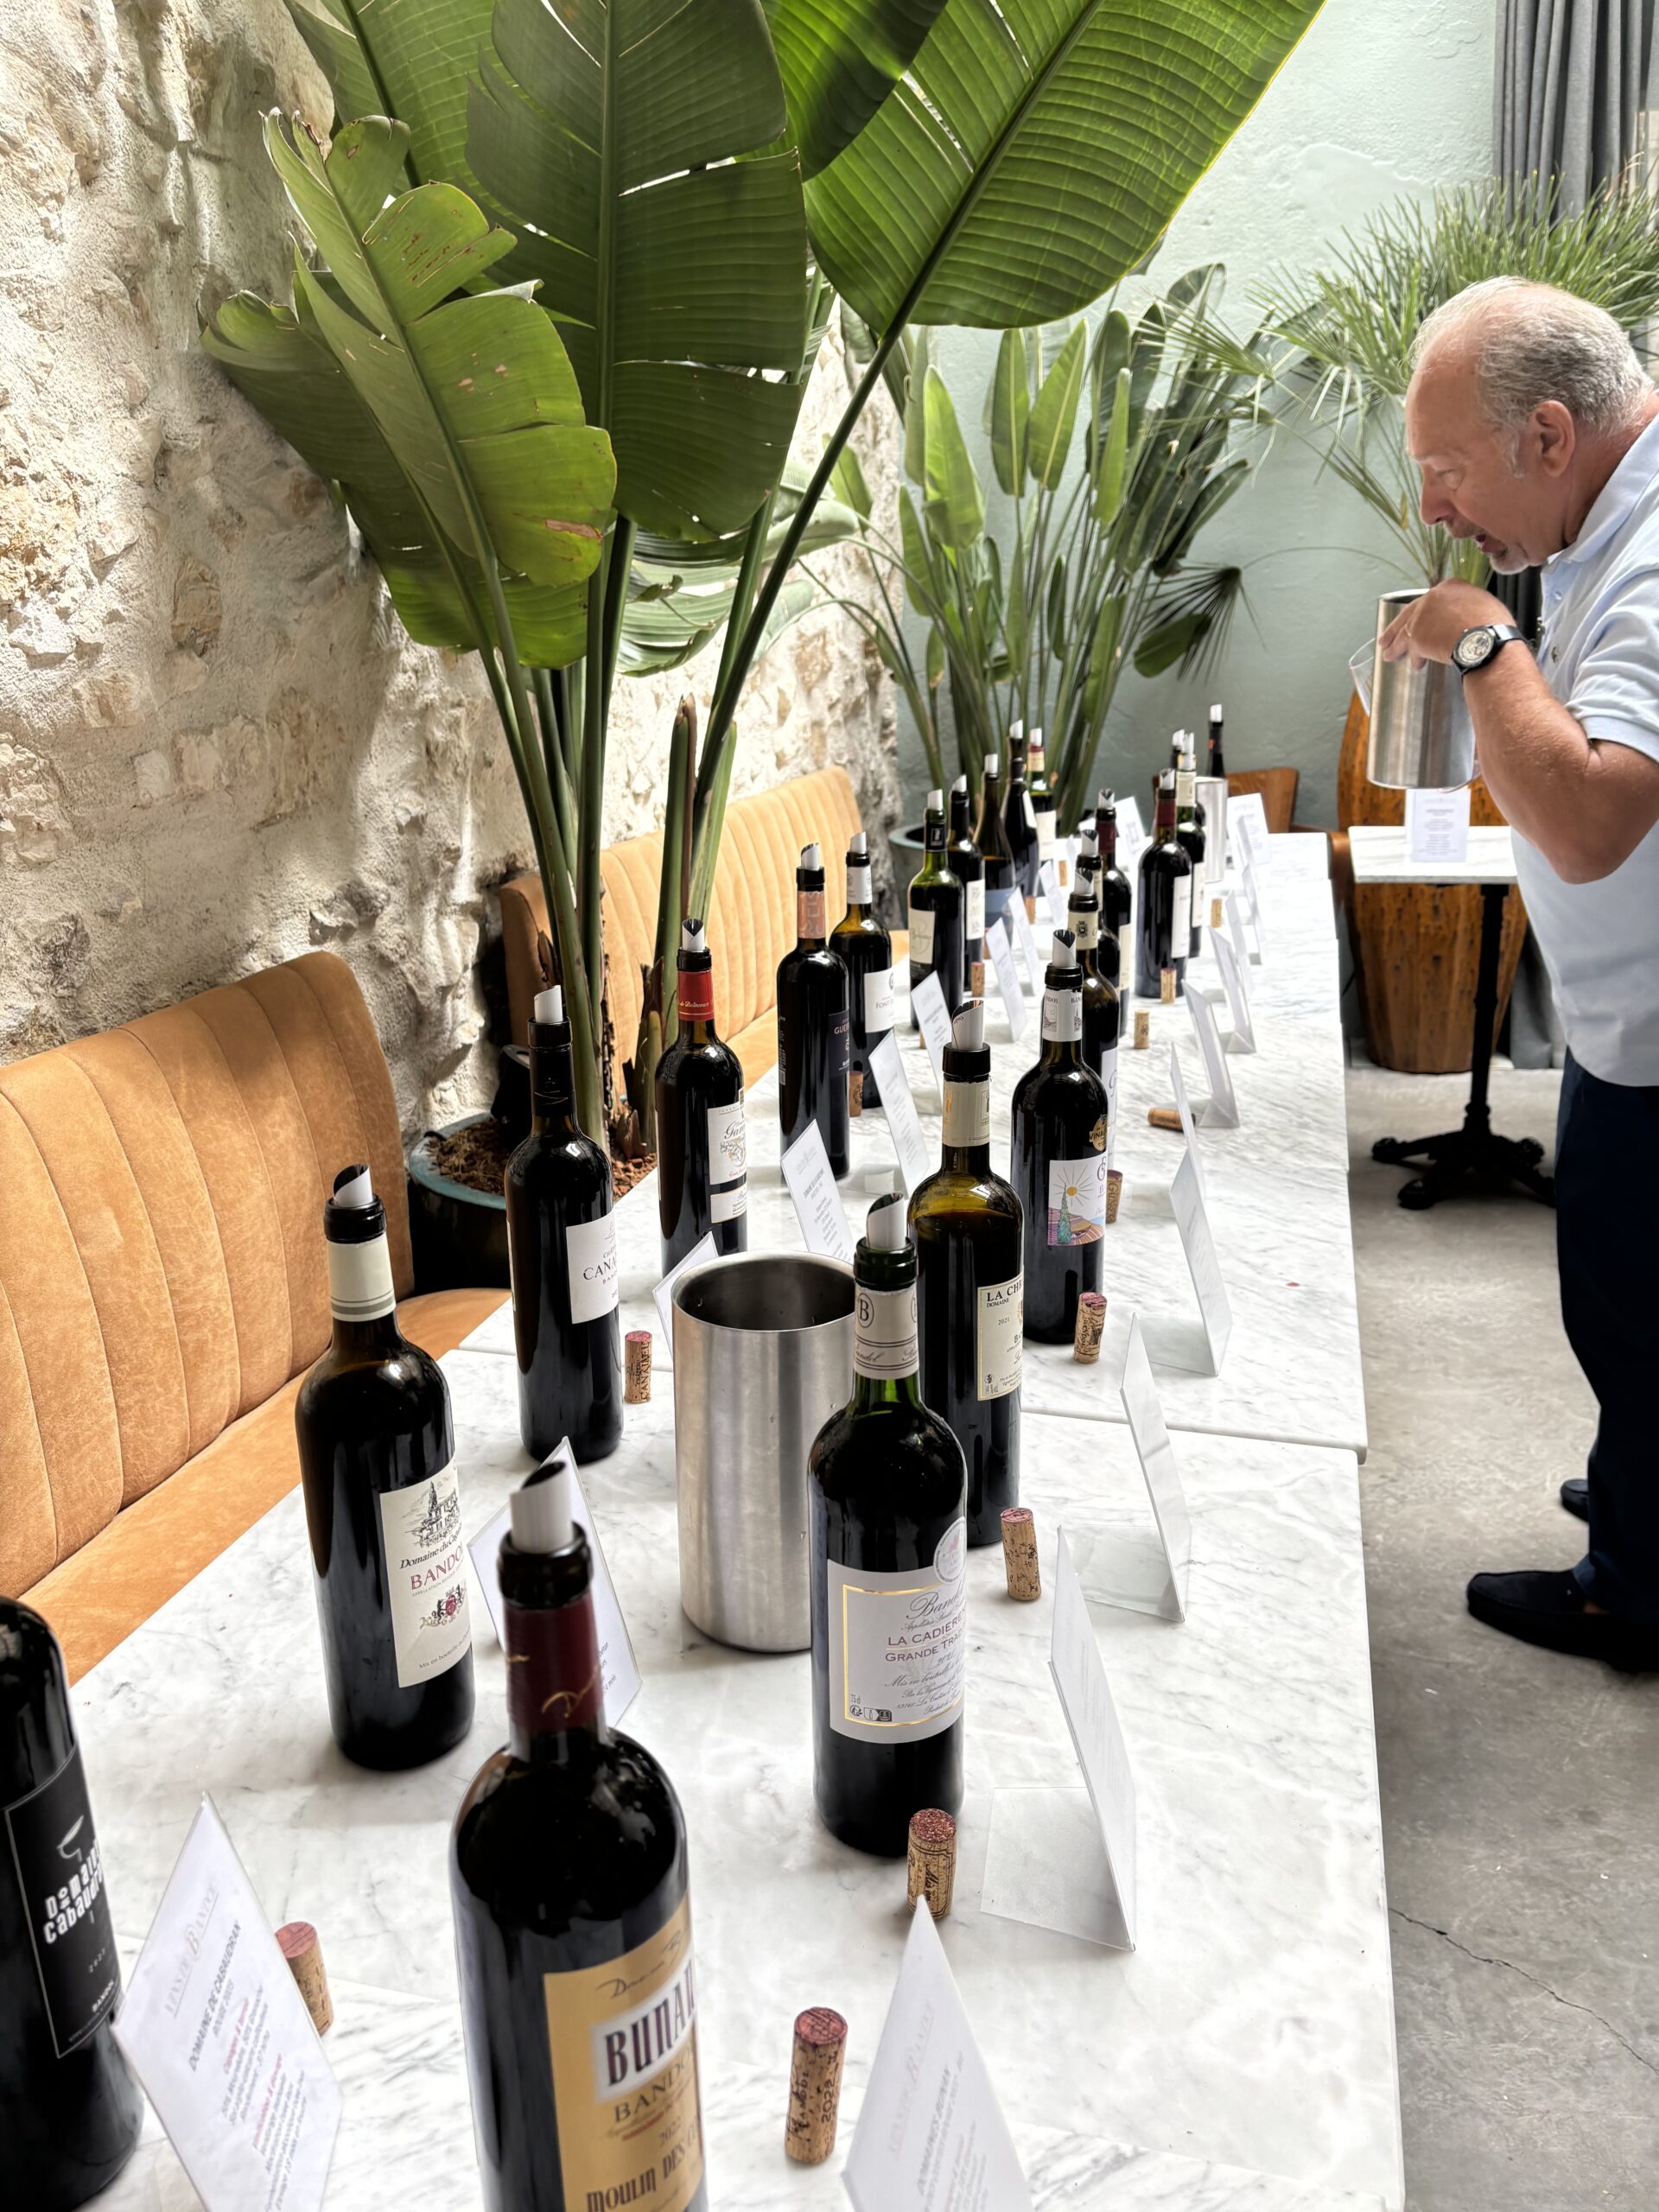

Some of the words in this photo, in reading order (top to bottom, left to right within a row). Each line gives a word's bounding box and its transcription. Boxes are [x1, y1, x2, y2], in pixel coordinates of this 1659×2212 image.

[987, 1292, 1003, 1302] LA
[987, 1298, 1010, 1308] DOMAINE
[860, 1299, 869, 1321] B
[998, 1316, 1010, 1325] 2021
[855, 1351, 886, 1363] andol
[399, 1548, 439, 1569] Domaine
[888, 1636, 907, 1646] LA
[885, 1645, 939, 1662] GRANDE
[614, 2045, 691, 2124] BANDO
